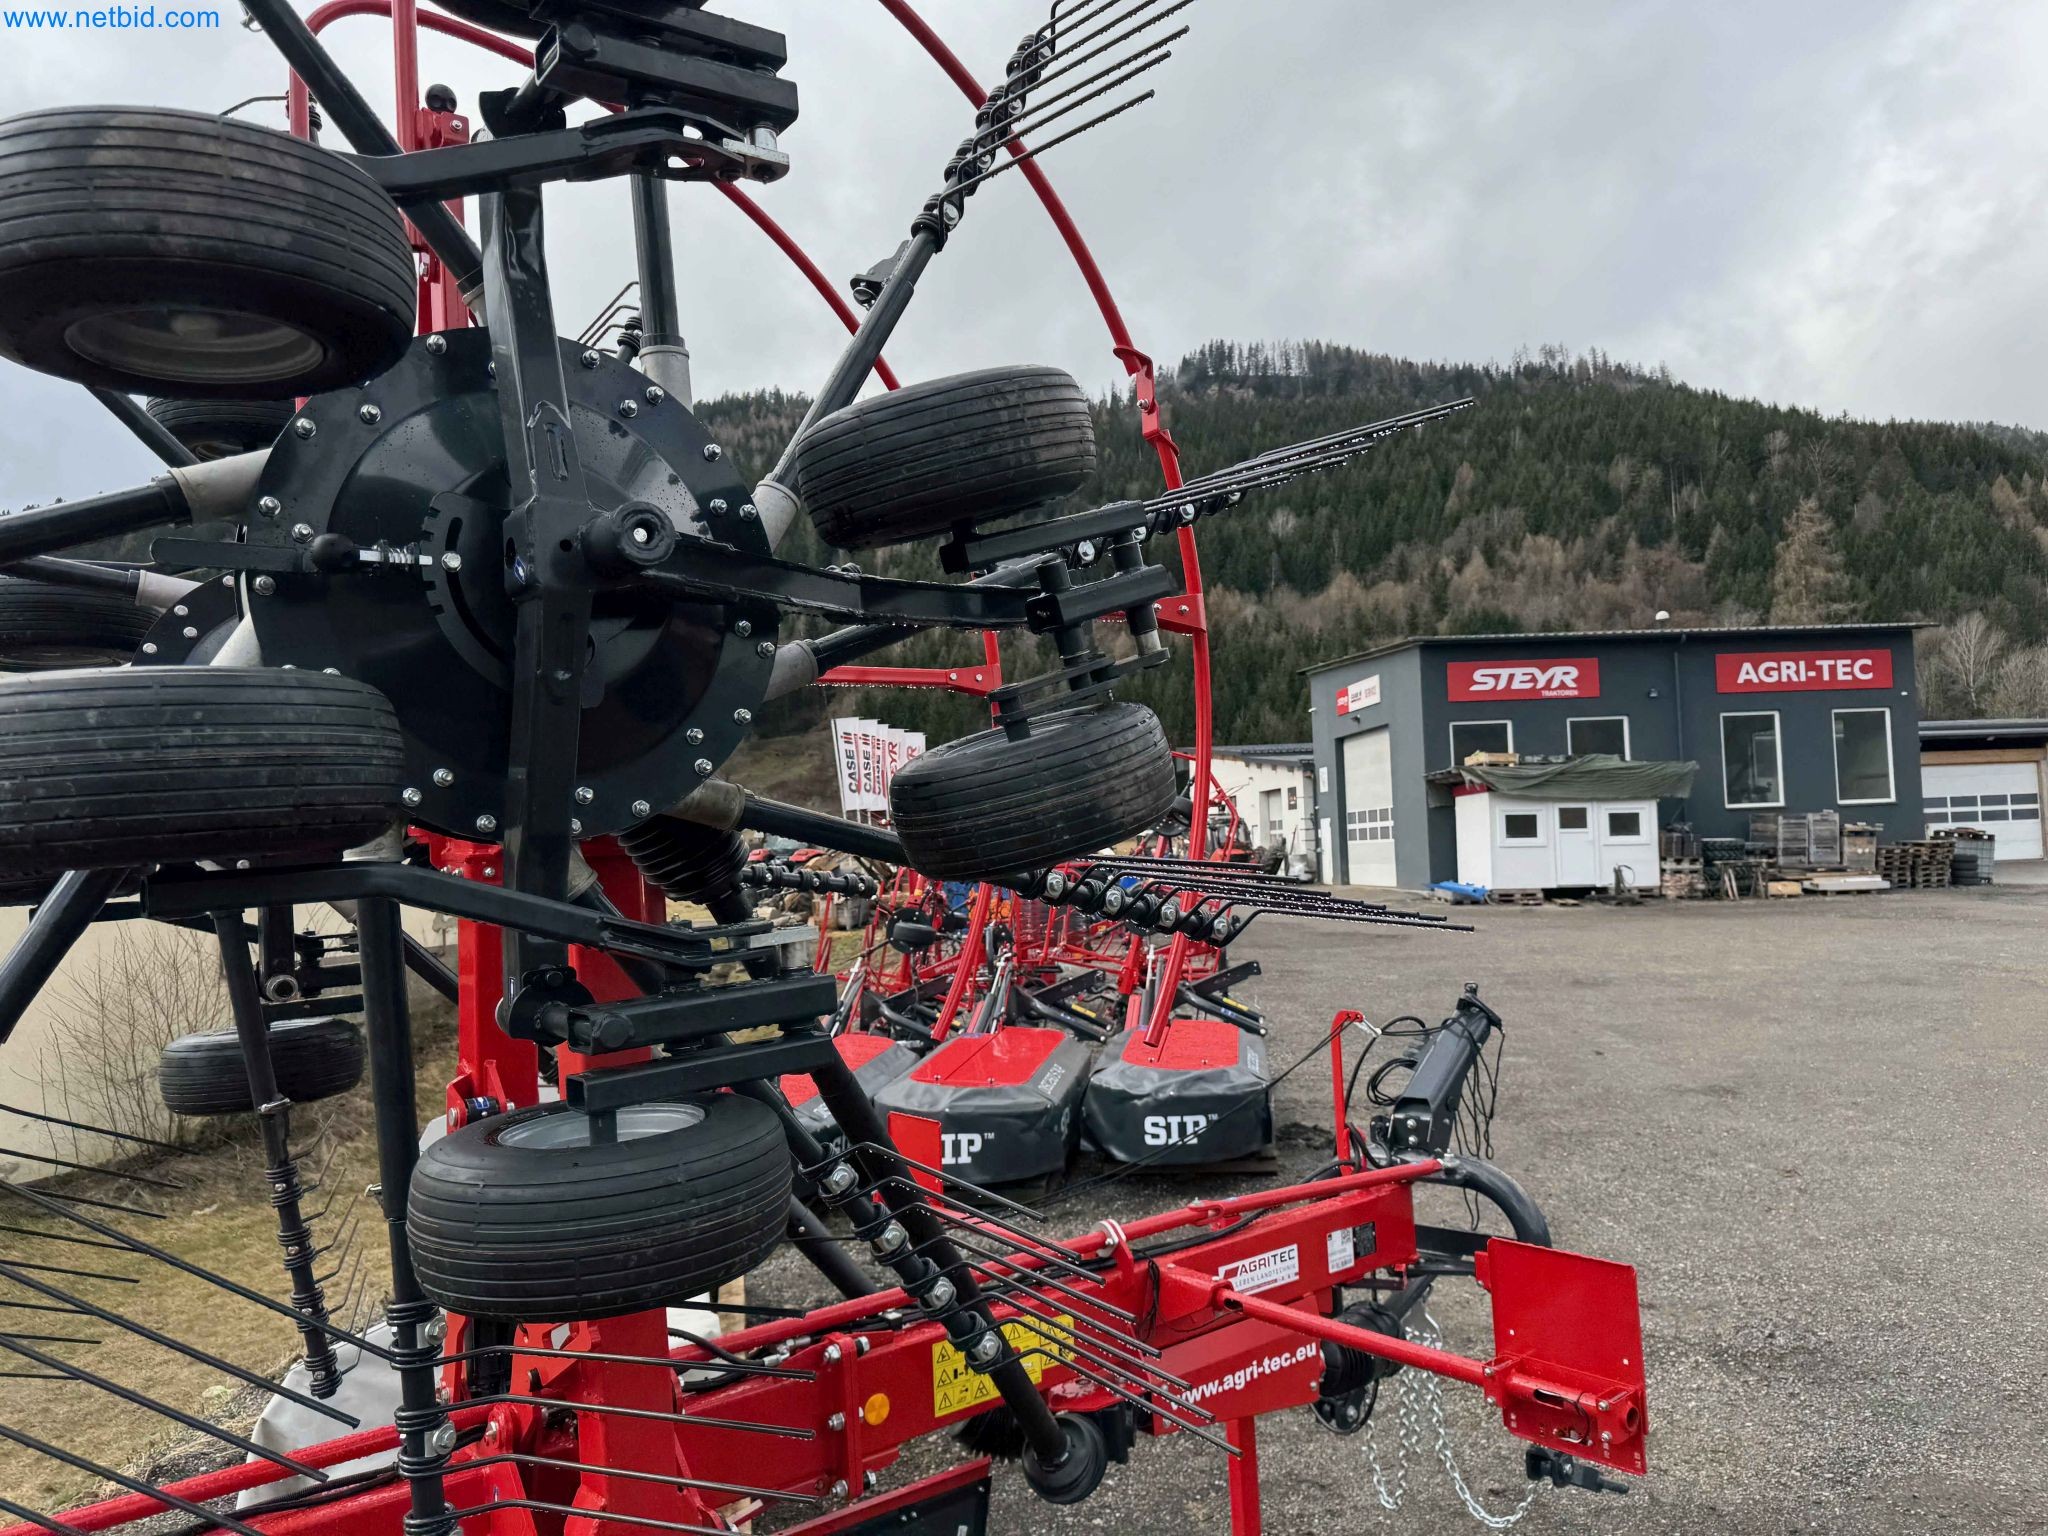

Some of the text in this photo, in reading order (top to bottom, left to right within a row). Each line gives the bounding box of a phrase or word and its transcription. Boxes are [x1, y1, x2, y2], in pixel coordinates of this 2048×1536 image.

[1469, 665, 1579, 691] STEYR
[1737, 658, 1874, 684] AGRI-TEC
[1541, 689, 1579, 697] TRAKTOREN
[845, 748, 858, 794] CASE
[863, 749, 872, 794] CASE
[1240, 1248, 1295, 1276] AGRITEC
